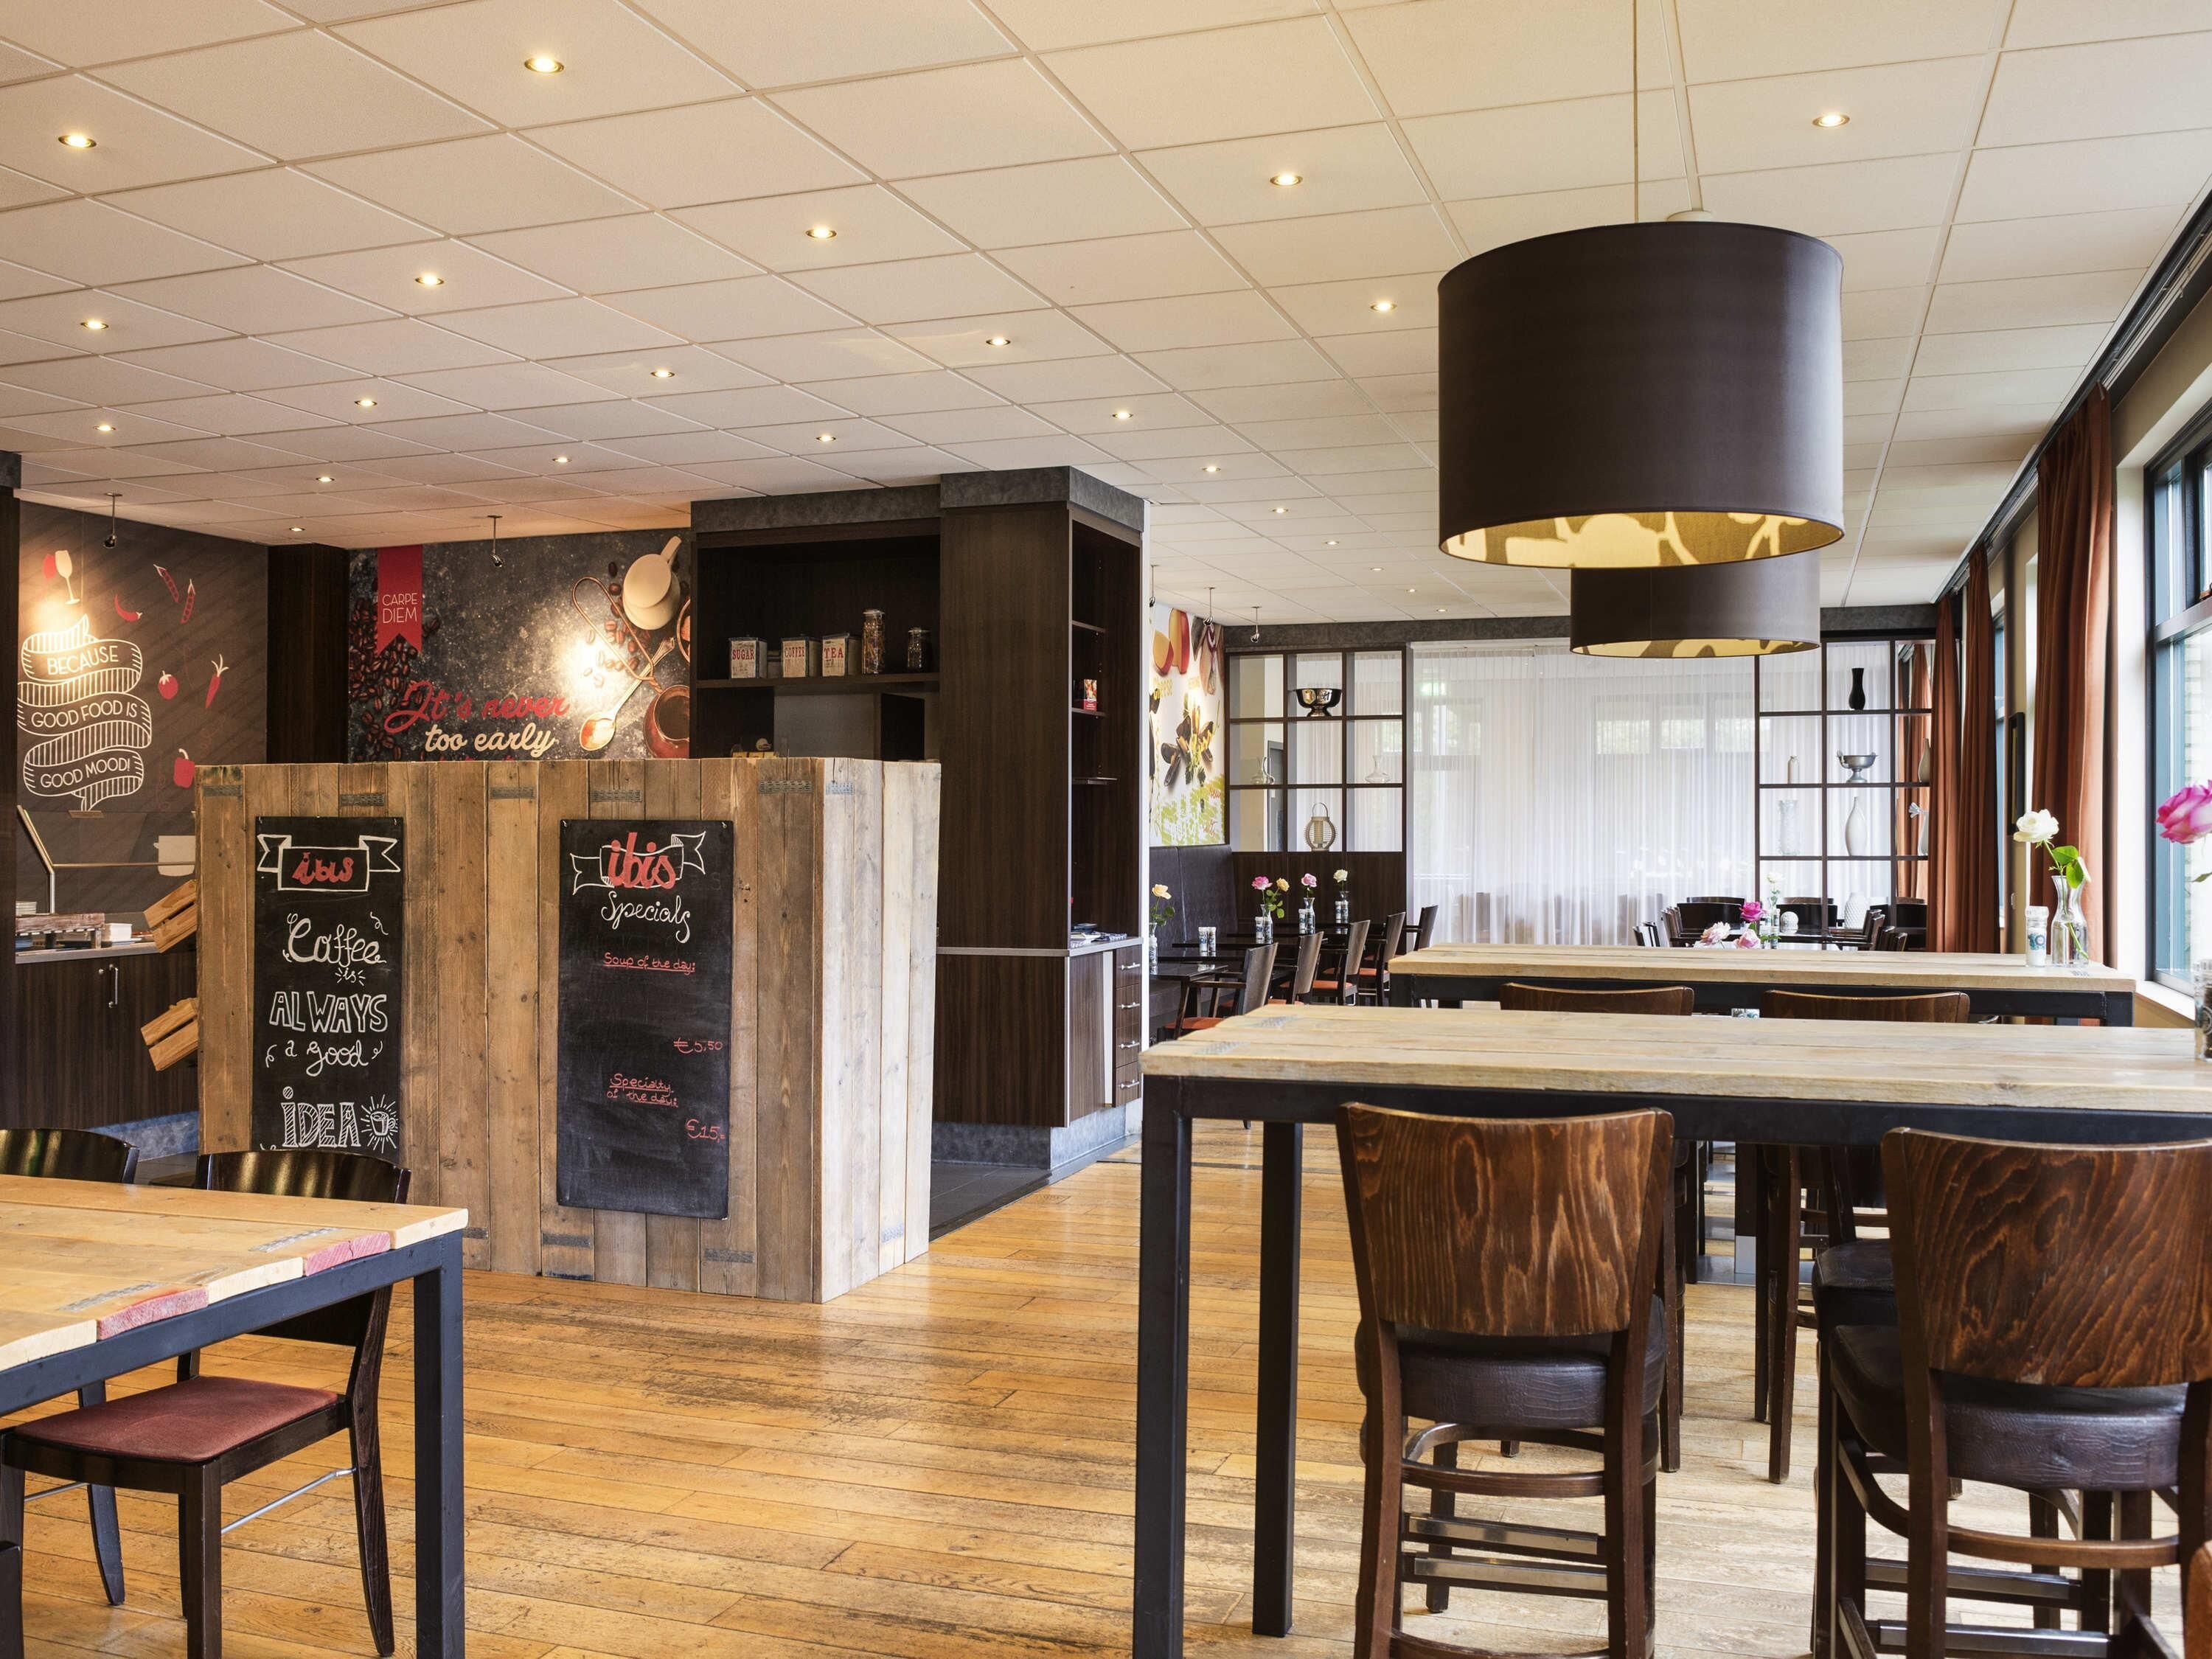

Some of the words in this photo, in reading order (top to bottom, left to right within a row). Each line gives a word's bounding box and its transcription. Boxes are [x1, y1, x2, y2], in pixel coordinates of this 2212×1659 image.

[382, 593, 419, 607] CARPE
[382, 608, 418, 624] DIEM
[47, 646, 119, 675] BECAUSE
[732, 649, 755, 661] SUGAR
[785, 647, 805, 658] COFFEE
[824, 647, 844, 658] TEA
[31, 712, 79, 728] GOOD
[82, 700, 123, 721] FOOD
[126, 703, 137, 717] IS
[383, 681, 472, 734] It's
[481, 693, 571, 720] never
[425, 725, 467, 752] too
[474, 722, 558, 758] early
[41, 770, 83, 788] GOOD
[85, 757, 131, 779] MOOD!
[608, 832, 676, 889] ibis
[601, 891, 691, 944] Specials
[285, 914, 387, 967] Coffee
[344, 967, 358, 984] is
[604, 952, 634, 969] Soup
[637, 955, 649, 970] of
[652, 958, 670, 968] the
[673, 959, 695, 975] day:
[269, 992, 388, 1033] ALWAYS
[285, 1040, 297, 1057] a
[306, 1040, 369, 1077] good
[607, 1088, 619, 1099] of
[626, 1091, 647, 1103] the
[610, 1074, 672, 1097] Specialty
